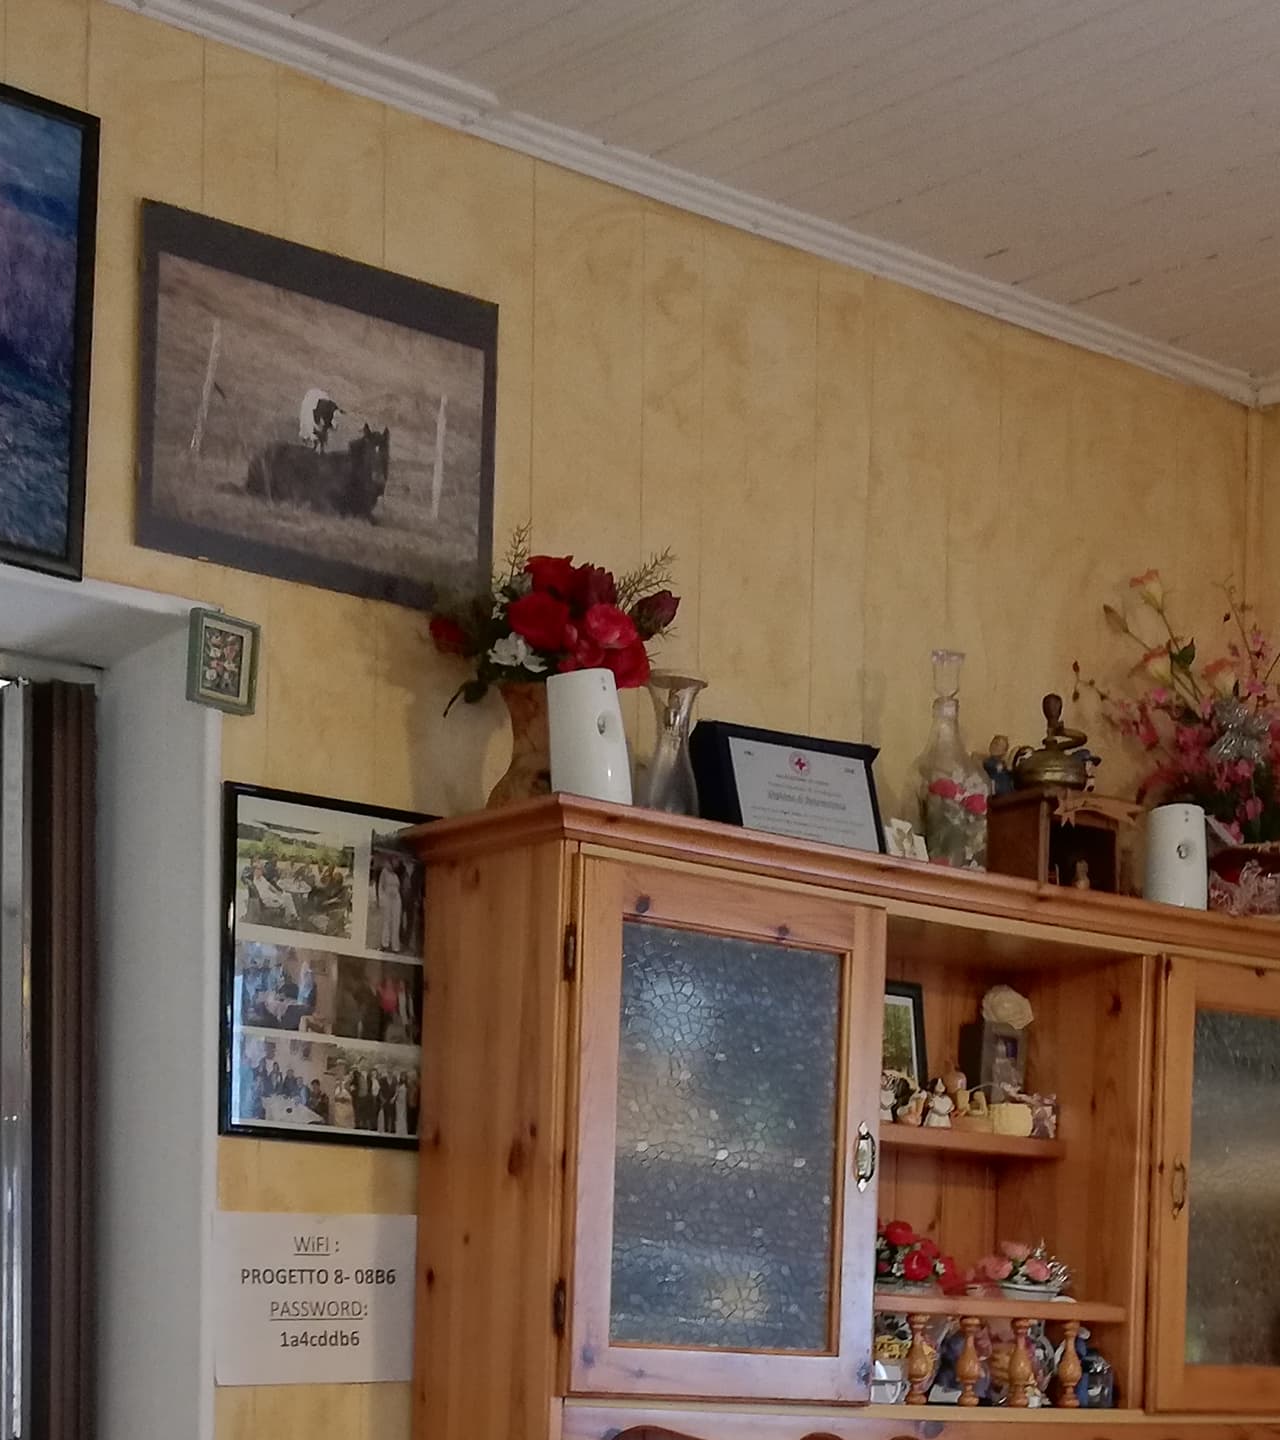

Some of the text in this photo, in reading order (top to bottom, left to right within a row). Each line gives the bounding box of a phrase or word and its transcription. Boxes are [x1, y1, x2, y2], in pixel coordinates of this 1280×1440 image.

[241, 1268, 328, 1285] PROGETTO
[354, 1268, 396, 1285] 08B6
[271, 1300, 368, 1317] PASSWORD:
[280, 1330, 360, 1347] 1a4cddb6
